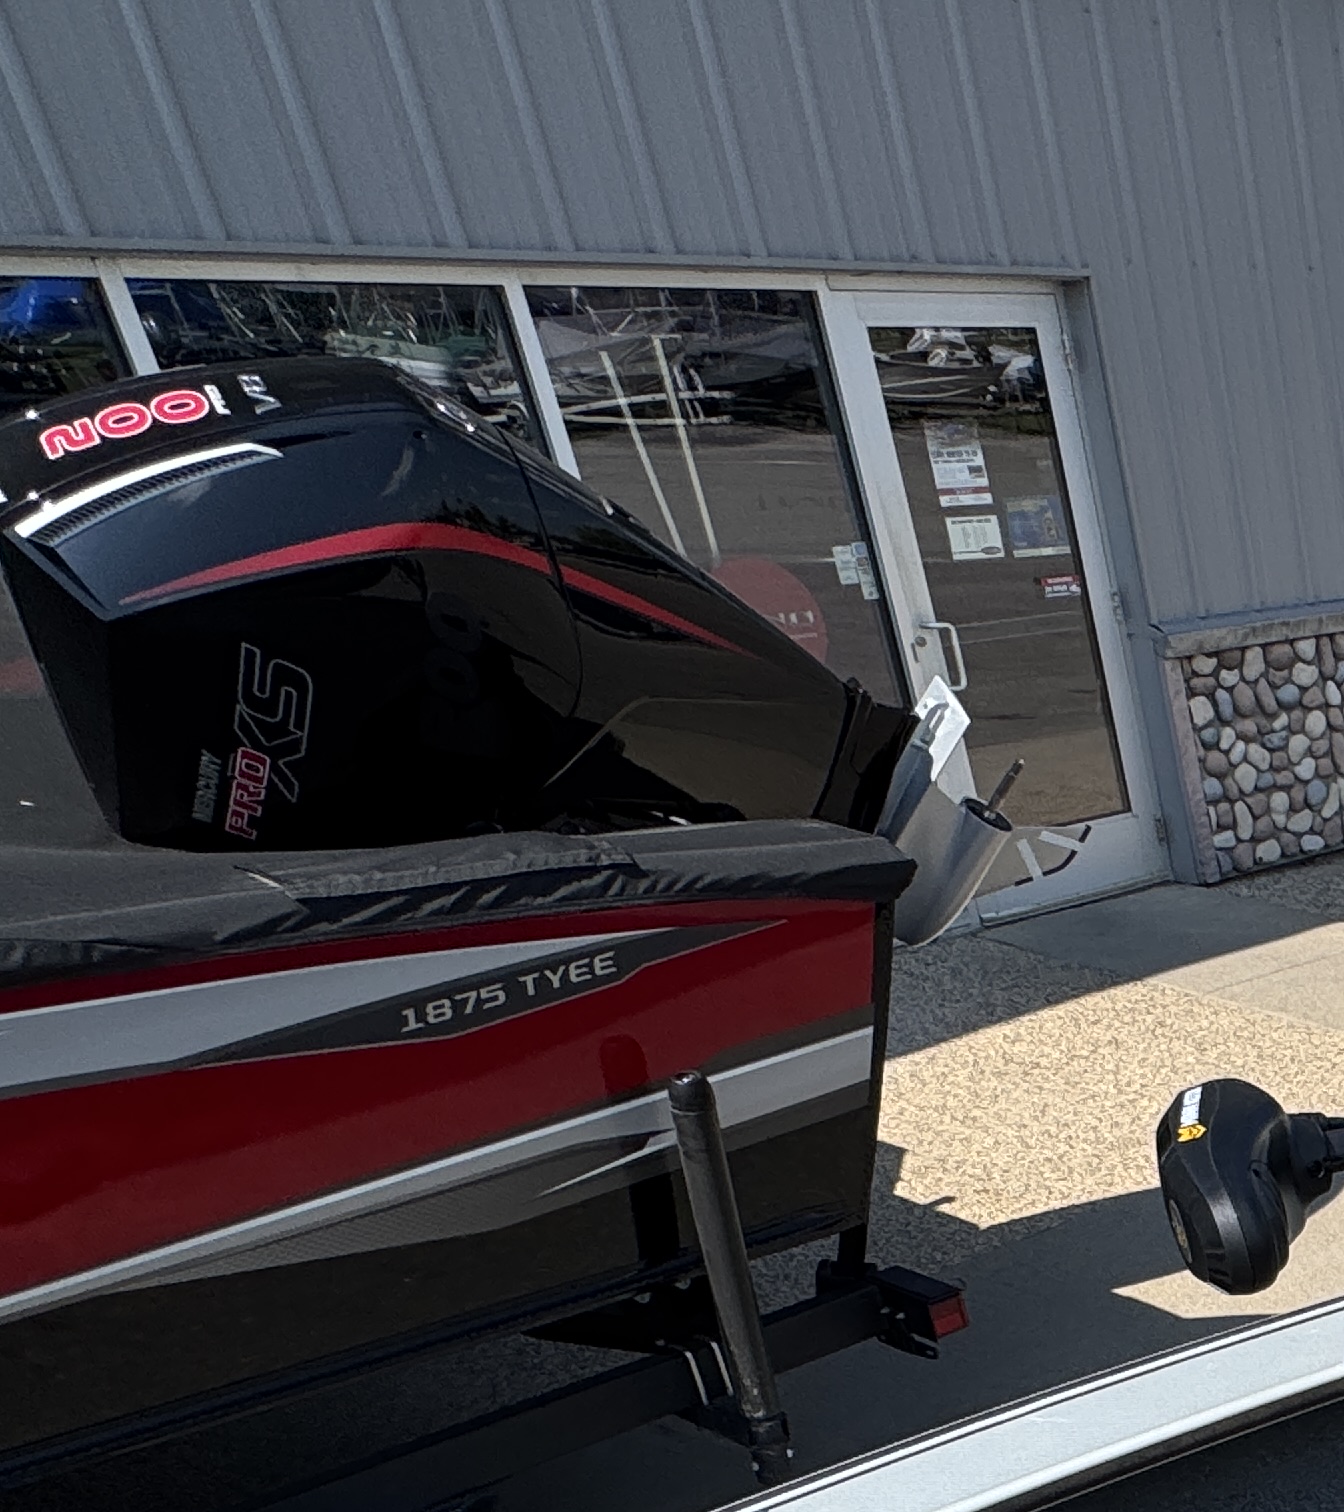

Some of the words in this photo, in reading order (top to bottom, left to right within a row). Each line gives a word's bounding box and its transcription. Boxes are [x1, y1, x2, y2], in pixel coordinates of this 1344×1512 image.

[39, 390, 210, 460] 200
[225, 747, 270, 840] PRO
[401, 983, 507, 1033] 1875
[518, 951, 618, 996] TYEE
